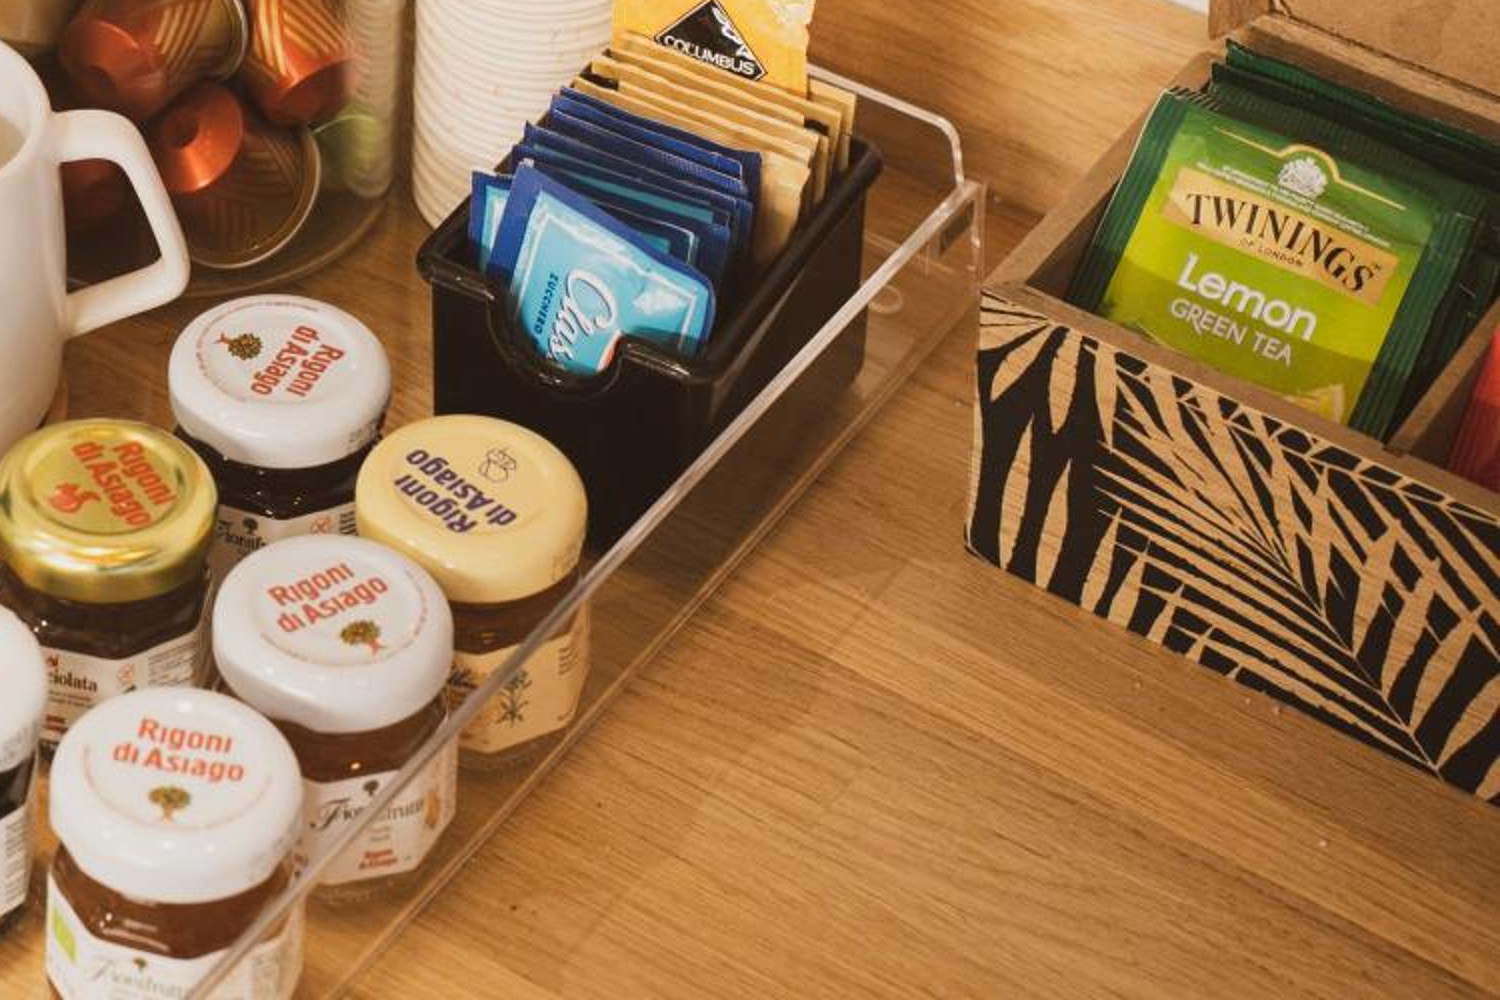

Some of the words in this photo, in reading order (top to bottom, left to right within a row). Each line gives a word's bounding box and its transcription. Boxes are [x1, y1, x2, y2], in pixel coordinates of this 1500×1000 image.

[663, 34, 756, 77] COLUMBUS
[1186, 191, 1374, 293] TWININGS
[1176, 251, 1318, 342] Lemon
[1168, 297, 1249, 347] GREEN
[1252, 328, 1292, 367] TEA
[286, 343, 347, 398] Rigoni
[113, 440, 176, 505] Rigoni
[393, 474, 479, 533] Rigoni
[268, 563, 355, 607] Rigoni
[136, 717, 234, 754] Rigoni
[142, 749, 245, 784] Asiago
